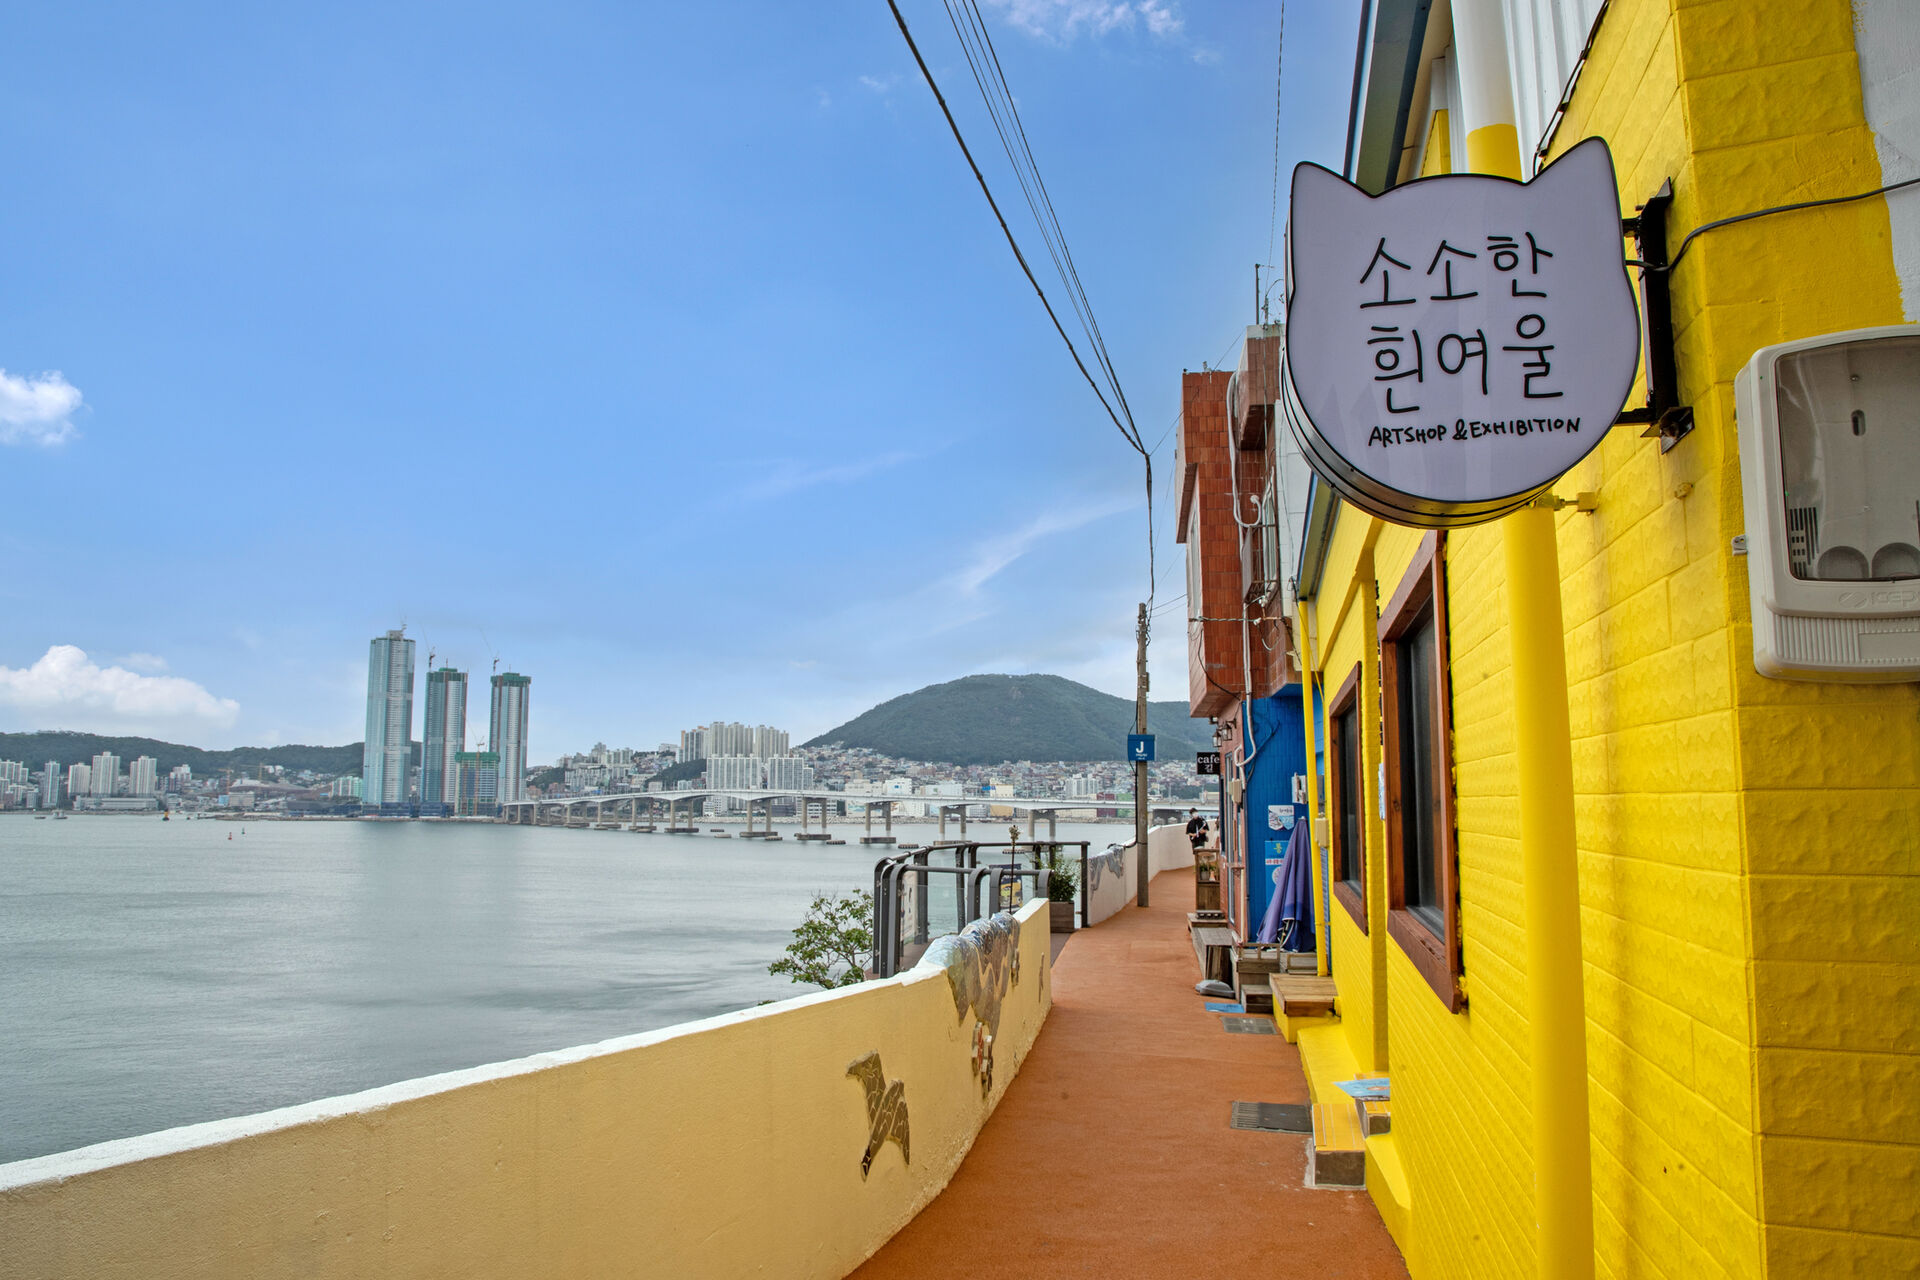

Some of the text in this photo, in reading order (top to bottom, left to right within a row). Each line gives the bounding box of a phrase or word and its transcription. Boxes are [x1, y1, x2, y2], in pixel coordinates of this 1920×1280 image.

[1359, 231, 1554, 309] 소소한
[1366, 312, 1564, 413] 흰여울
[1368, 424, 1447, 448] ARTSHOP
[1135, 741, 1145, 753] J
[1197, 754, 1220, 764] cafe
